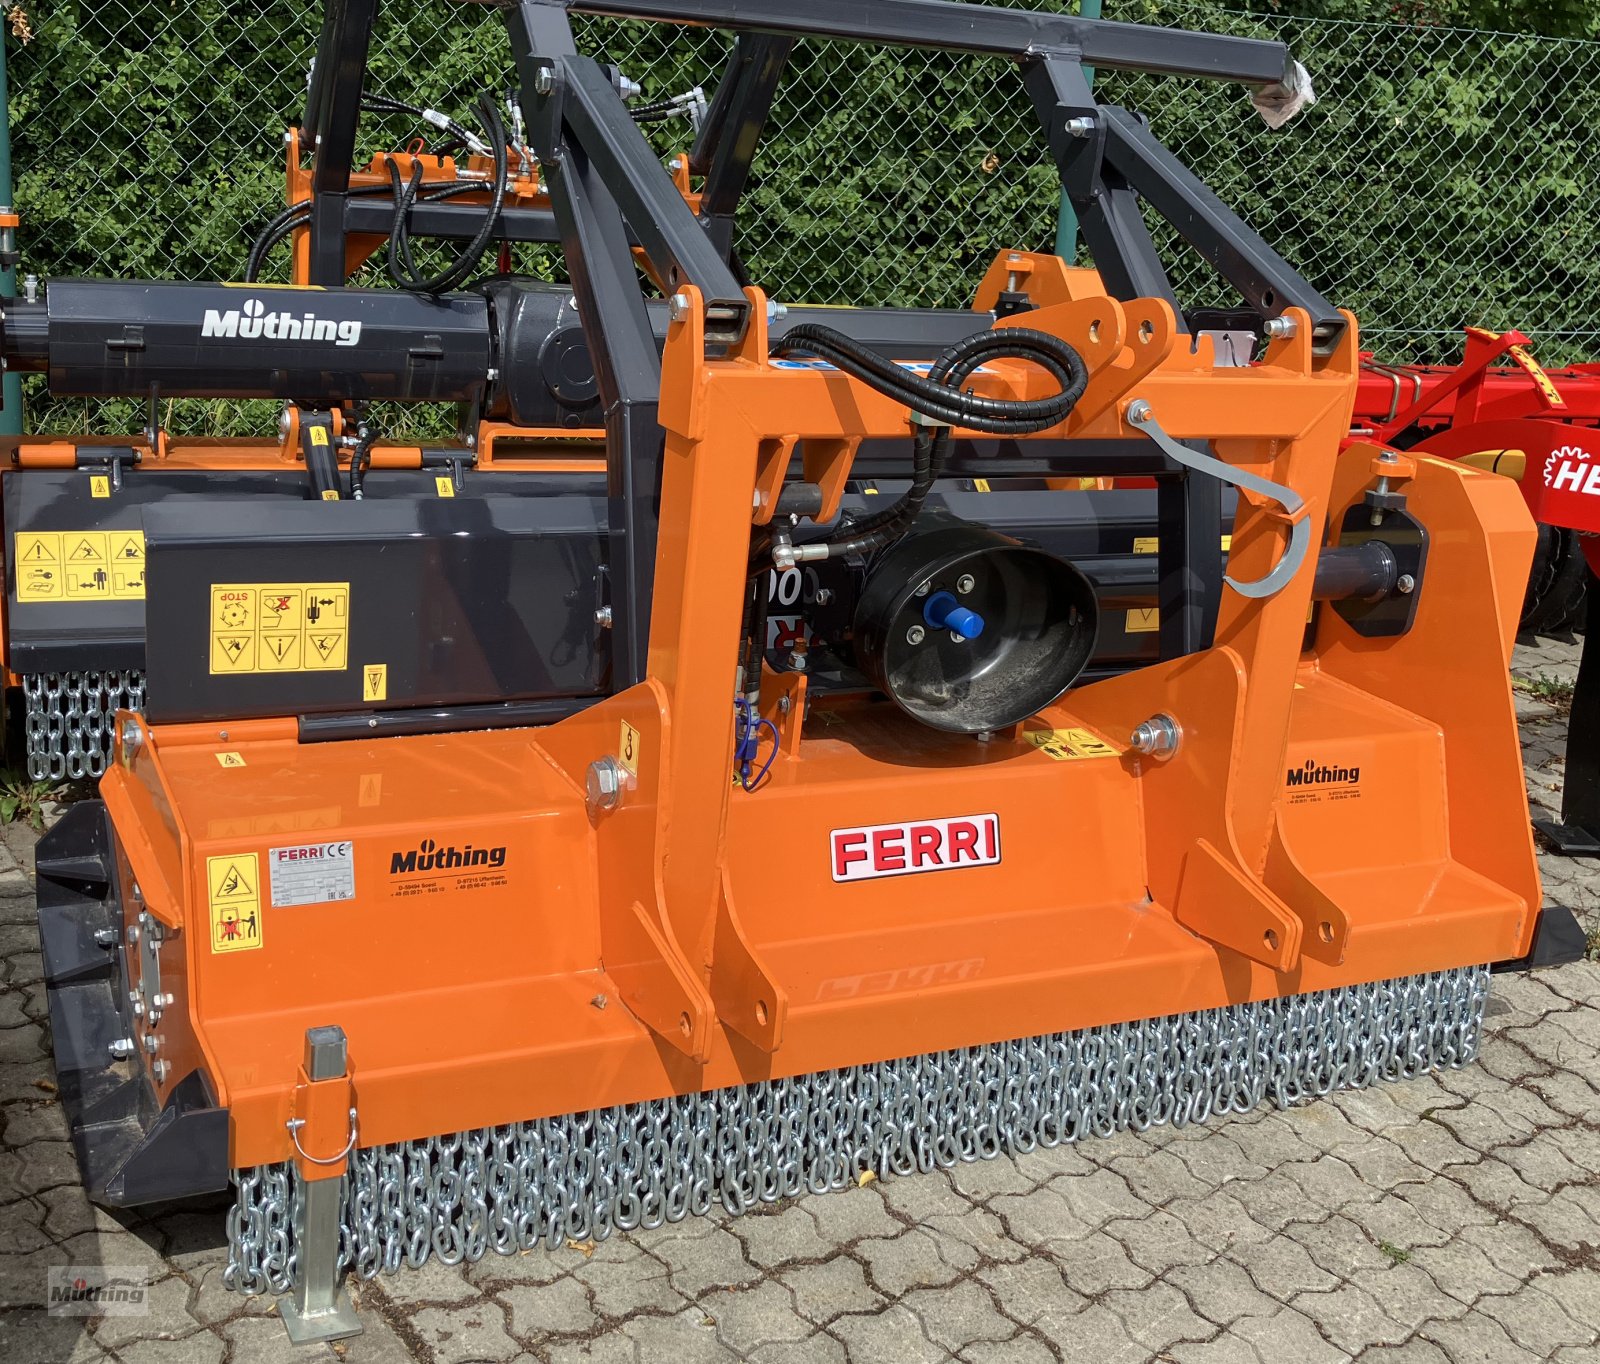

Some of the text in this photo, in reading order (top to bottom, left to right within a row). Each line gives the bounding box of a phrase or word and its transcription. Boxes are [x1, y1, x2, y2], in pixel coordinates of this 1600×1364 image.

[220, 592, 248, 601] STOP
[278, 847, 325, 861] FERRI
[834, 819, 997, 876] FERRI
